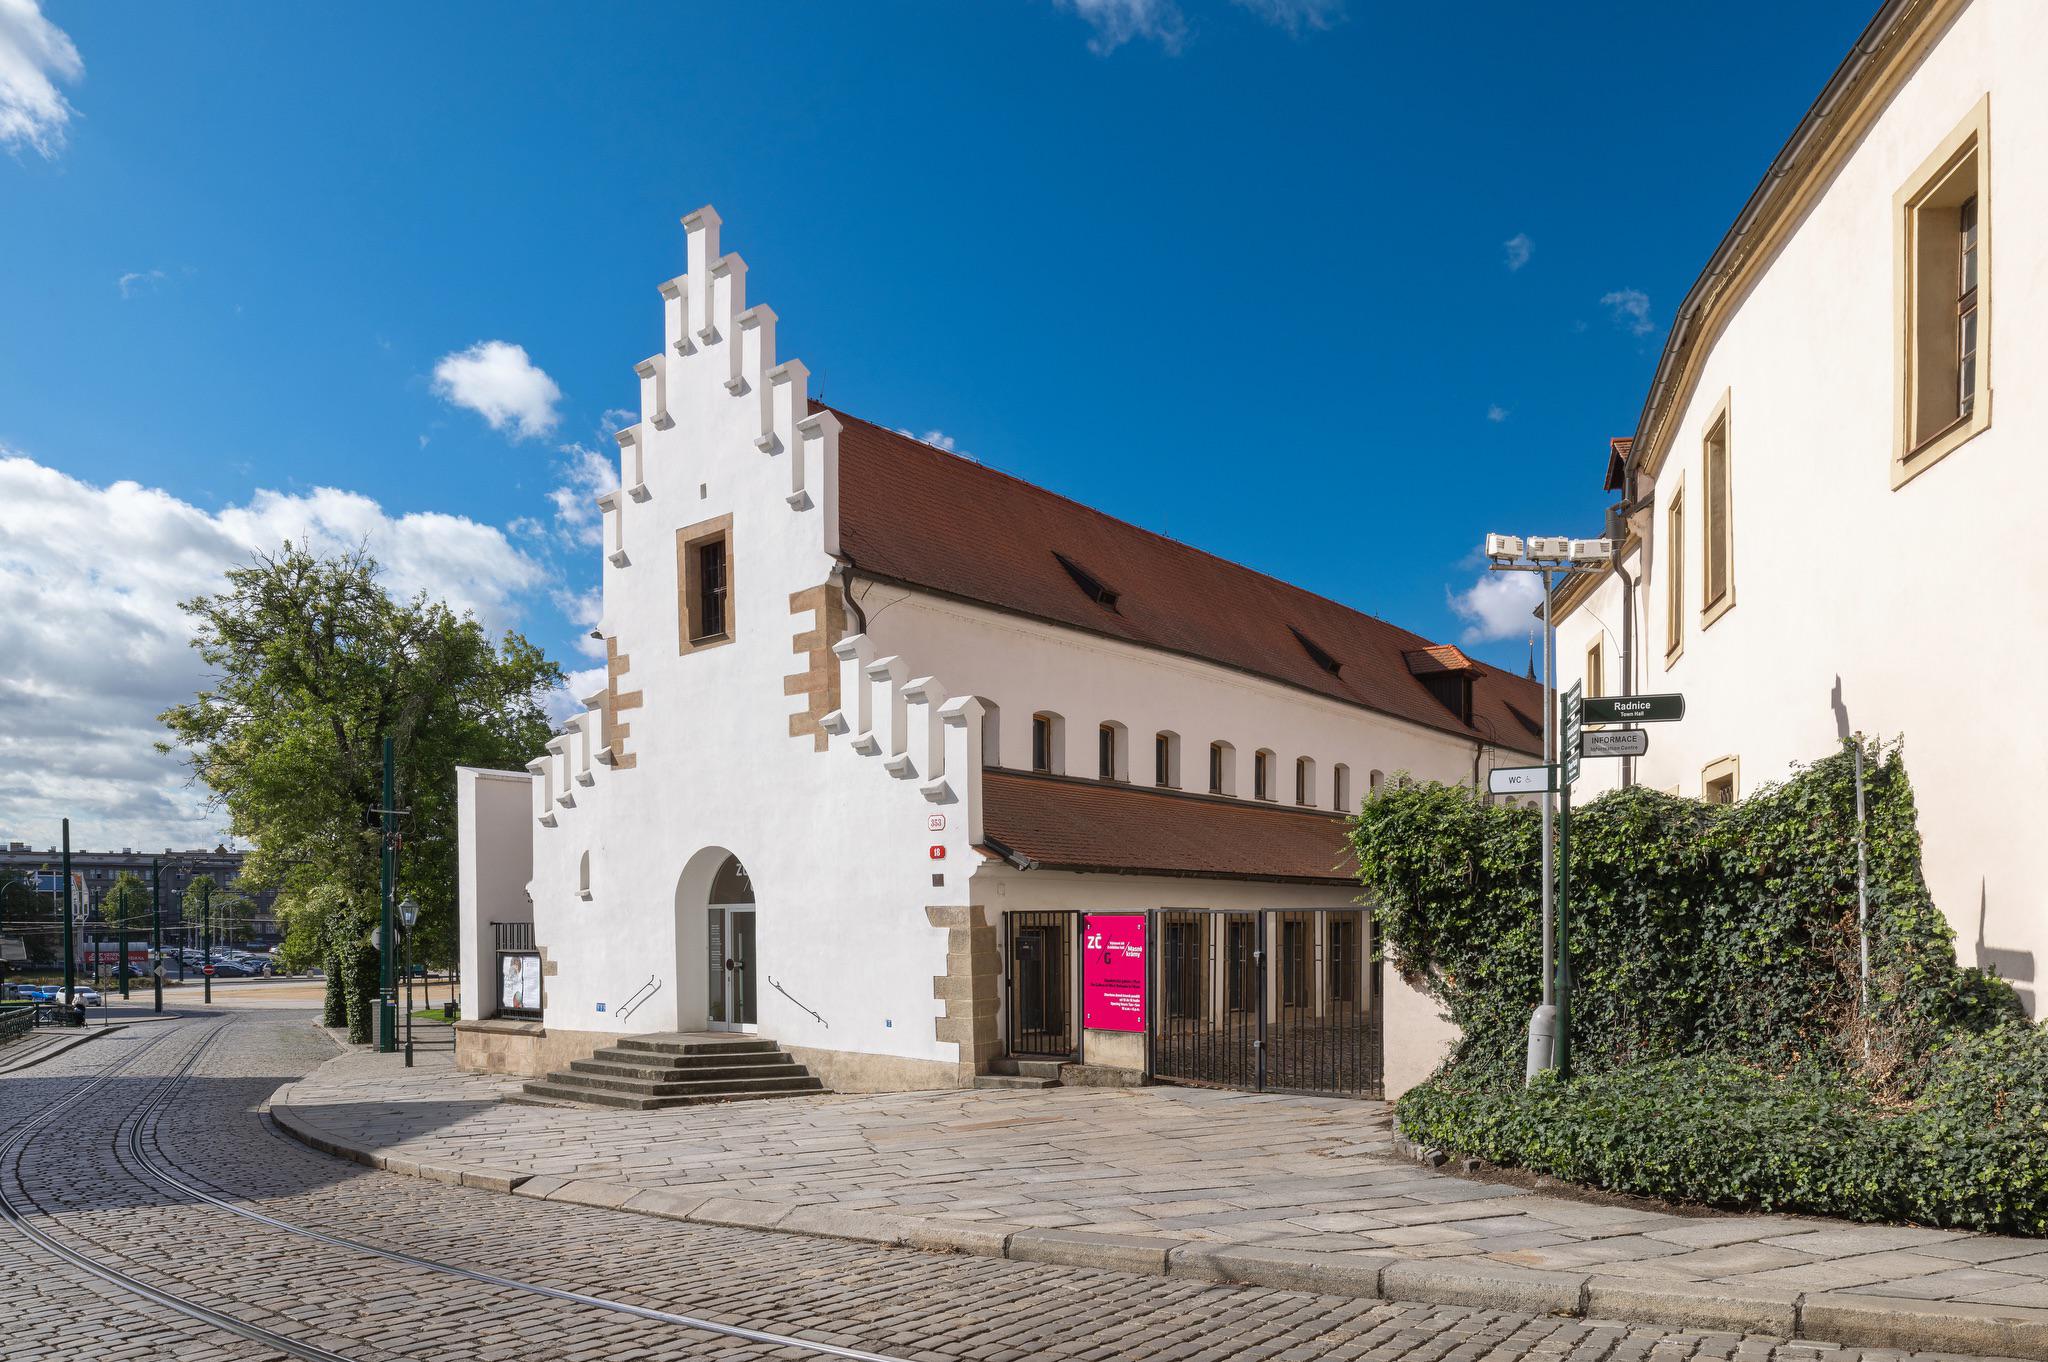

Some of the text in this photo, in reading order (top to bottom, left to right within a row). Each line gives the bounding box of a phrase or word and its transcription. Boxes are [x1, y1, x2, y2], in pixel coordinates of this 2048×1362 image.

[1614, 701, 1651, 711] Radnice
[1591, 735, 1637, 744] INFORMACE
[1508, 776, 1522, 784] WC
[930, 819, 942, 827] 353
[934, 848, 941, 857] 18
[1087, 933, 1102, 949] ZČ
[1105, 952, 1111, 964] G
